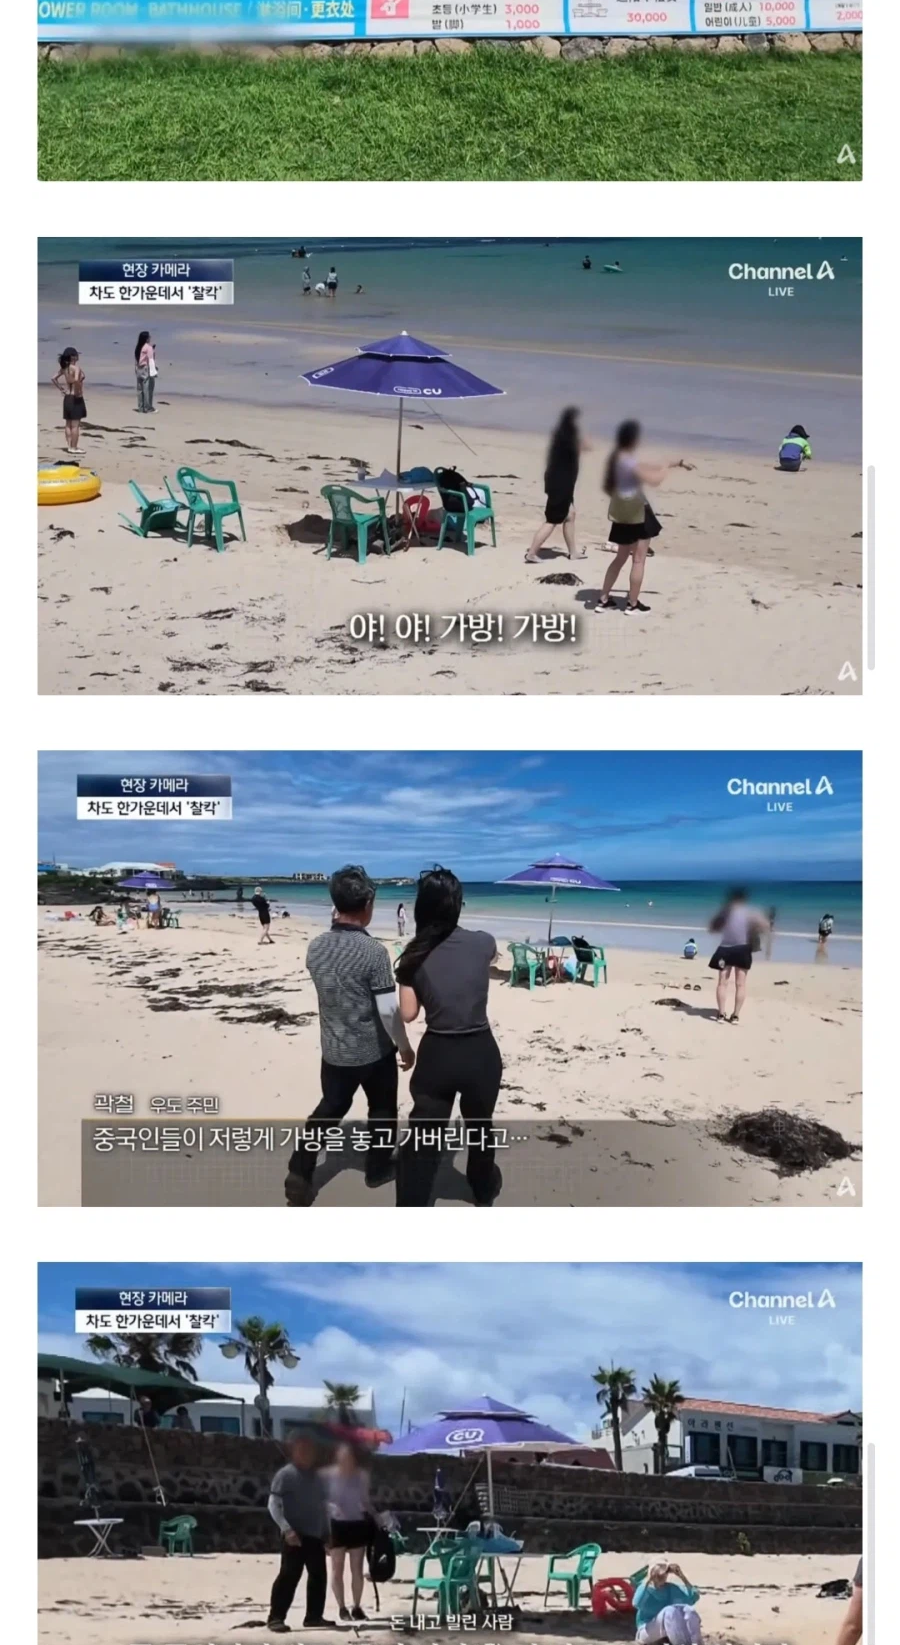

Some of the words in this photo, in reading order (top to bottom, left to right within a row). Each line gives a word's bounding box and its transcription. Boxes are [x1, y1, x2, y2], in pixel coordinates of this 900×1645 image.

[432, 5, 451, 15] 초등
[455, 4, 497, 15] (小学生)
[505, 5, 539, 15] 3,000
[705, 2, 722, 13] 일반
[725, 2, 752, 13] (成人)
[759, 2, 794, 11] 10,000
[627, 13, 667, 23] 30,000
[705, 16, 732, 27] 어린이
[766, 16, 795, 26] 5,000
[432, 20, 441, 29] 발
[506, 20, 540, 29] 1,000
[451, 1430, 480, 1443] CU
